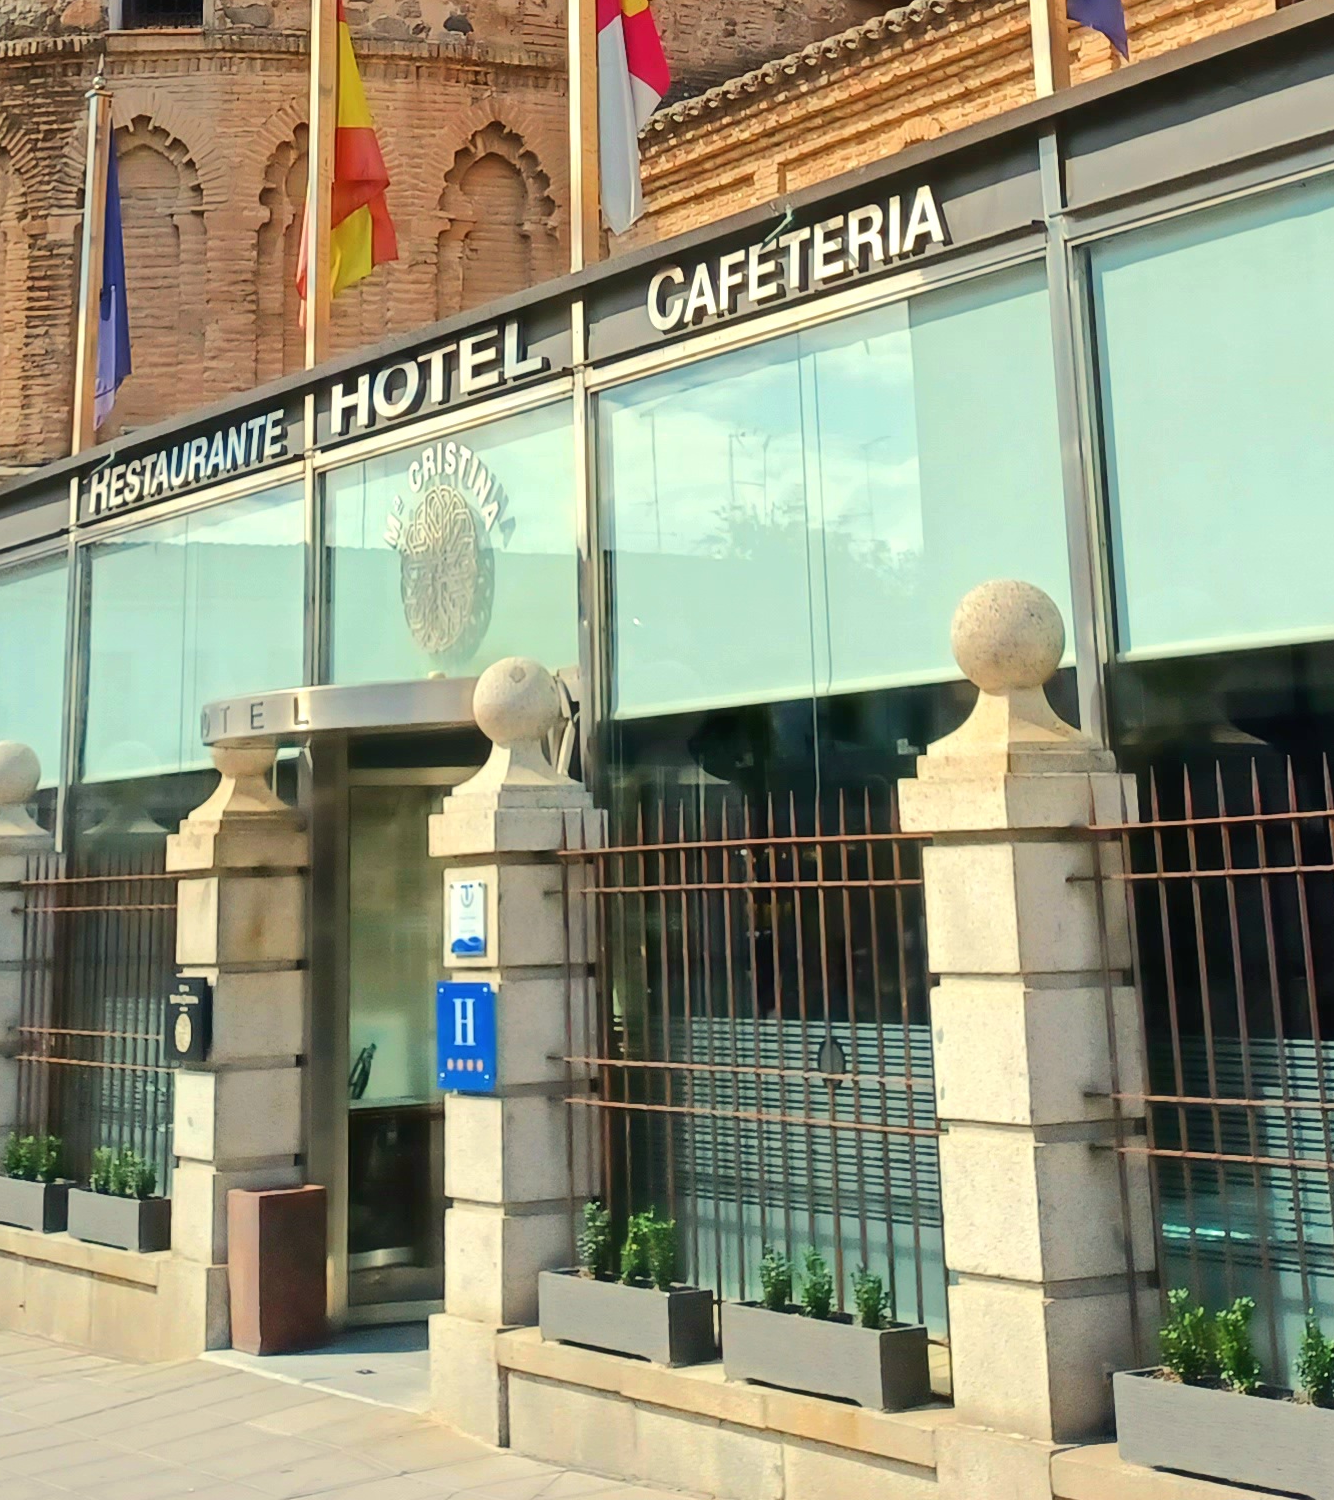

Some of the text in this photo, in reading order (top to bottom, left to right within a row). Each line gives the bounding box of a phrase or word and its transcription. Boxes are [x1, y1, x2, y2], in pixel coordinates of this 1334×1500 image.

[647, 185, 945, 332] CAFETERIA
[331, 317, 544, 434] HOTEL
[88, 408, 285, 513] RESTAURANTE
[408, 441, 500, 533] CRISTINA
[452, 998, 476, 1046] H
